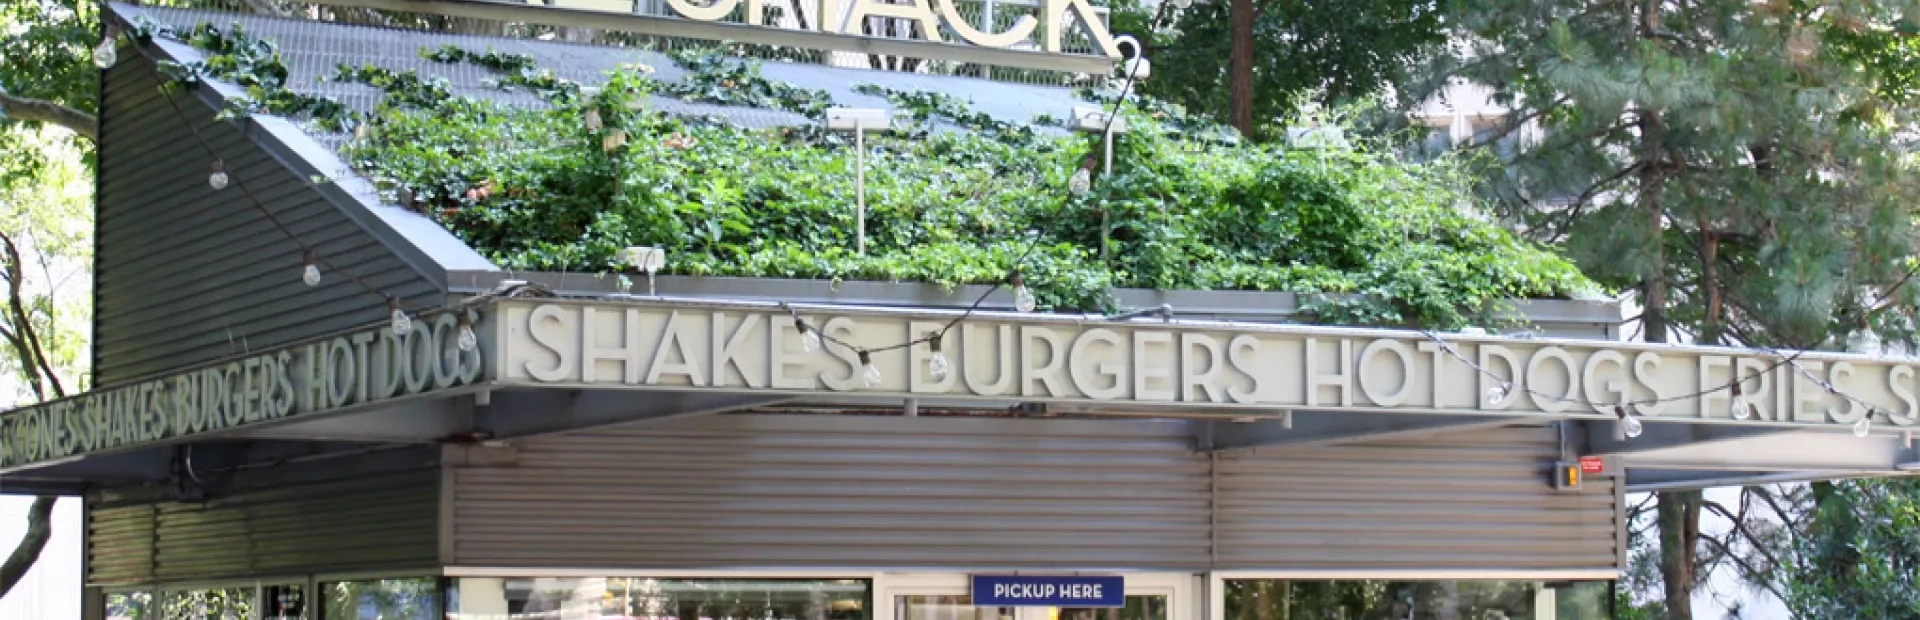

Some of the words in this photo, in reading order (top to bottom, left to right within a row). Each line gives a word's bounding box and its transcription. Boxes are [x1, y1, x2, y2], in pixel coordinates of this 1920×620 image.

[82, 379, 166, 451] SHAKES
[176, 350, 295, 436] BURGERS
[306, 331, 374, 412] HOT
[379, 306, 482, 399] DOGS
[524, 304, 861, 391] SHAKES
[909, 320, 1262, 403] BURGERS
[1305, 338, 1458, 409] HOT
[1478, 343, 1664, 417] DOGS
[1700, 355, 1862, 424] FRIES
[994, 583, 1055, 598] PICKUP
[1059, 583, 1104, 598] HERE
